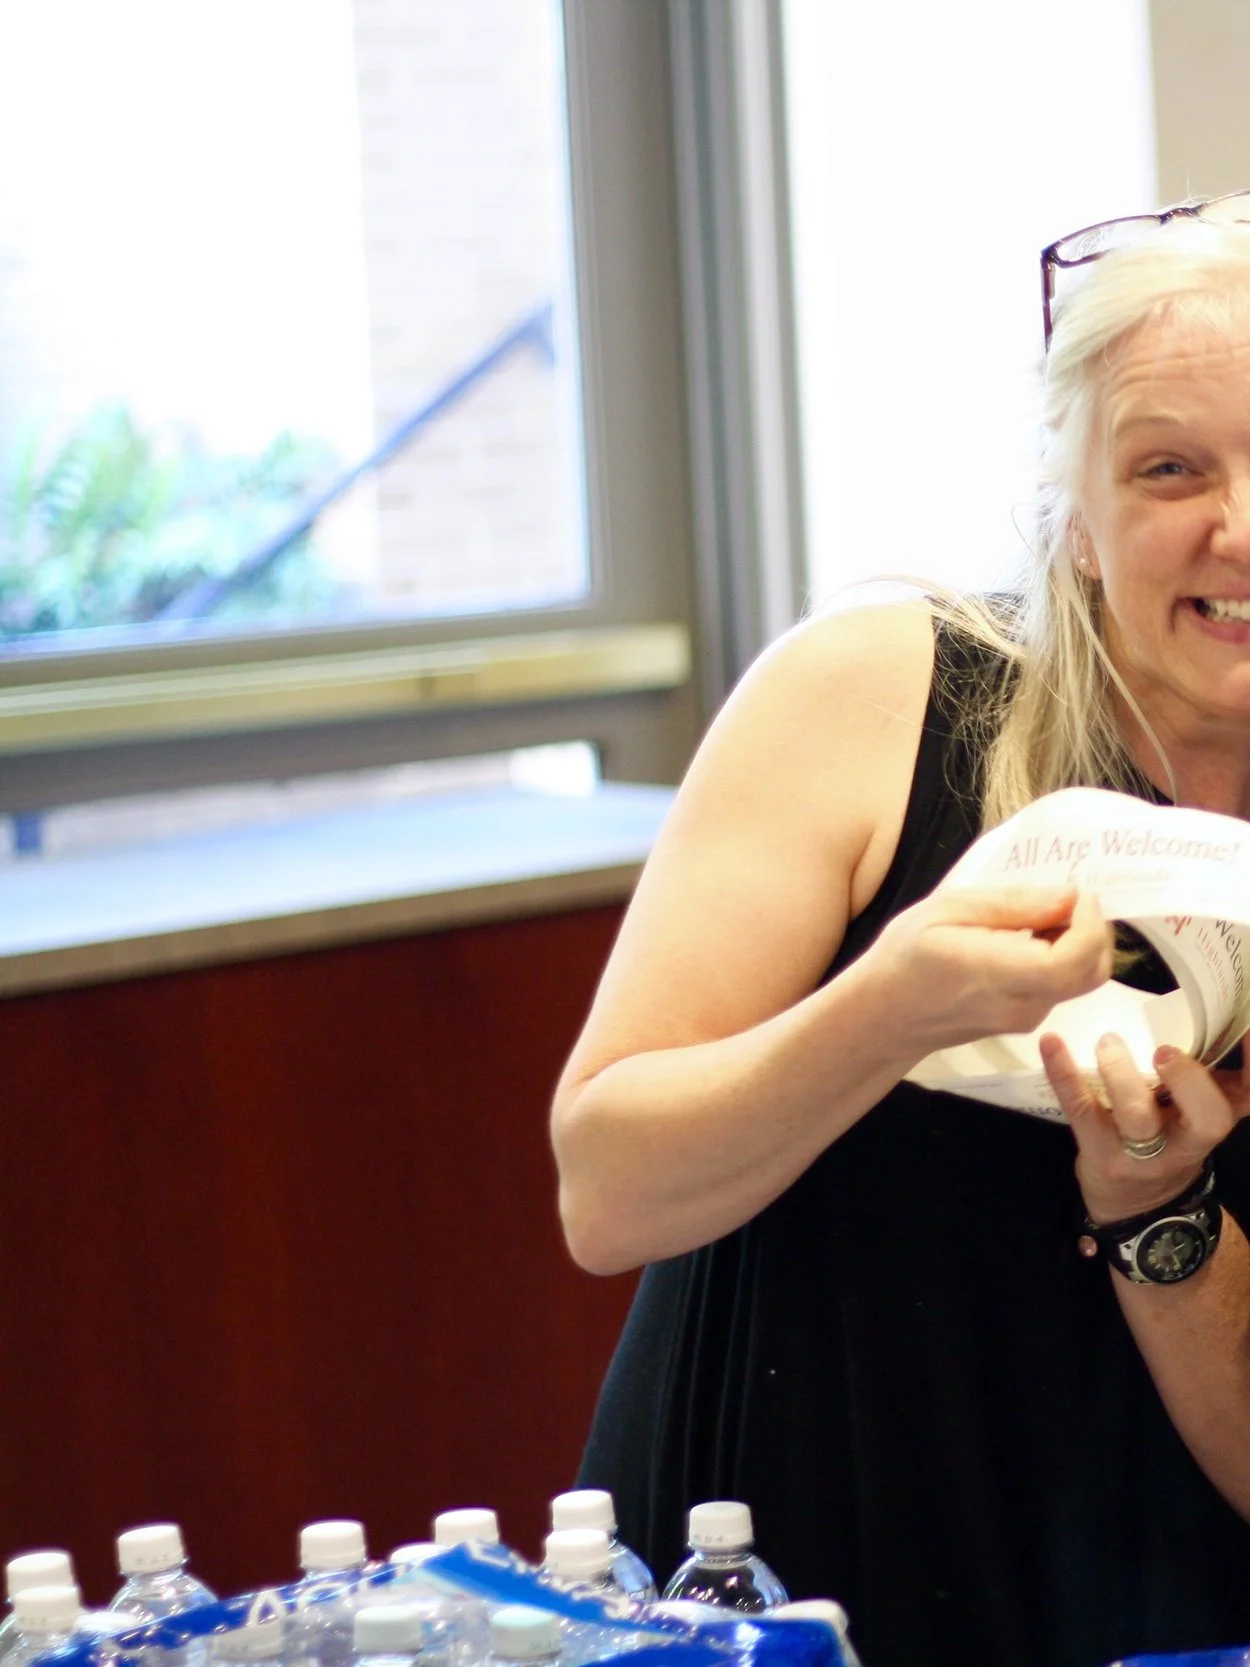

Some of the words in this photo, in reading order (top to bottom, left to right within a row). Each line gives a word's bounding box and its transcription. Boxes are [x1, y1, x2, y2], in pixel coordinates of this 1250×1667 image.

[1003, 835, 1040, 873] All
[1044, 835, 1092, 864] Are
[1102, 828, 1242, 865] Welcome!
